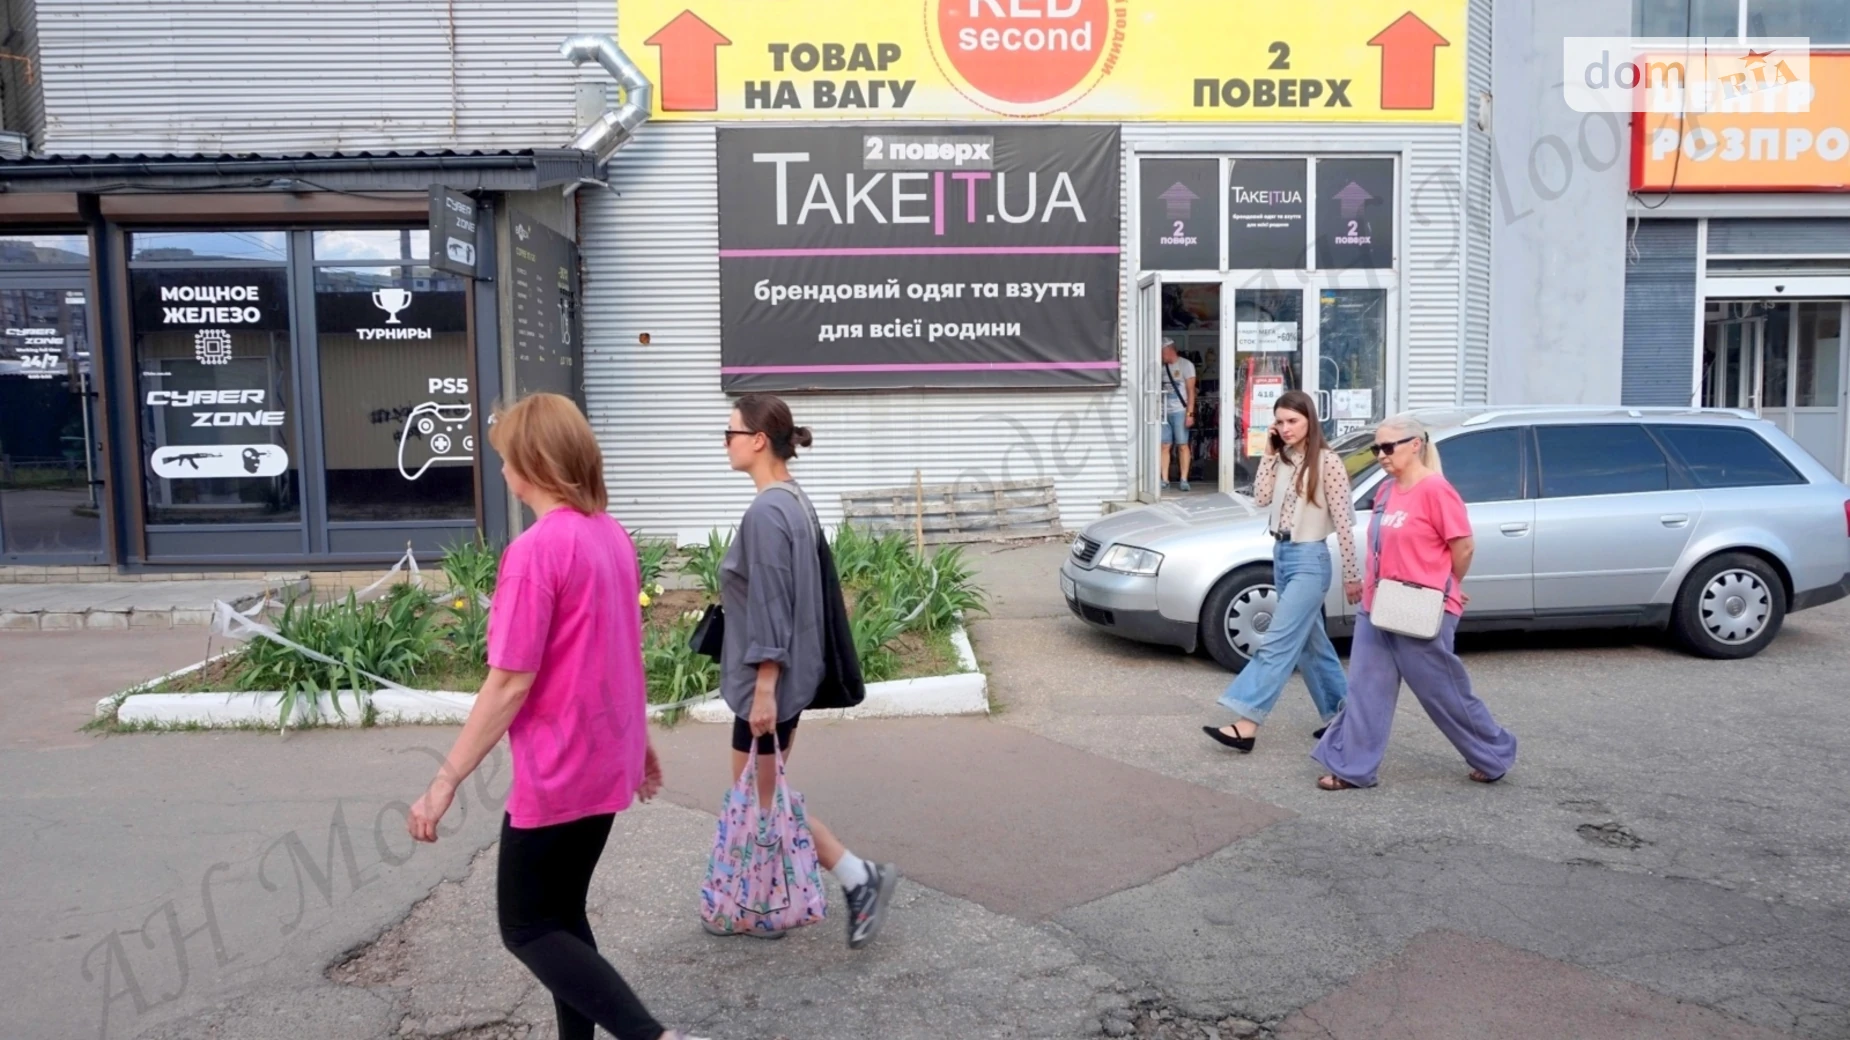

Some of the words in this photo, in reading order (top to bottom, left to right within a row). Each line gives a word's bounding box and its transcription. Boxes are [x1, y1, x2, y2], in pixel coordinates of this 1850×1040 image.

[958, 21, 1093, 51] second
[768, 42, 902, 72] ТОВАР
[1267, 41, 1290, 70] 2
[744, 80, 802, 109] НА
[813, 80, 916, 109] ВАГУ
[1193, 78, 1353, 108] ПОВЕРХ
[865, 137, 883, 160] 2
[889, 141, 990, 166] поверх
[1652, 126, 1850, 162] РОЗПРО
[445, 196, 472, 216] CYBER
[456, 216, 476, 233] ZONE
[1173, 220, 1184, 236] 2
[1347, 220, 1358, 236] 2
[1160, 236, 1198, 247] поверх
[1335, 236, 1371, 246] поверх
[160, 286, 260, 304] МОЩНОЕ
[753, 279, 900, 305] брендовий
[907, 283, 965, 301] одяг
[970, 282, 998, 298] та
[1006, 281, 1086, 303] взуття
[162, 306, 261, 324] ЖЕЛЕЗО
[5, 328, 56, 336] CYBER
[356, 327, 432, 340] ТУРНИРЫ
[818, 323, 863, 342] для
[870, 319, 922, 338] всієї
[929, 322, 1021, 342] родини
[24, 337, 64, 345] ZONE
[20, 353, 59, 369] 24/7
[428, 378, 469, 394] PS5
[146, 389, 265, 407] CYBER
[191, 410, 286, 427] ZONE
